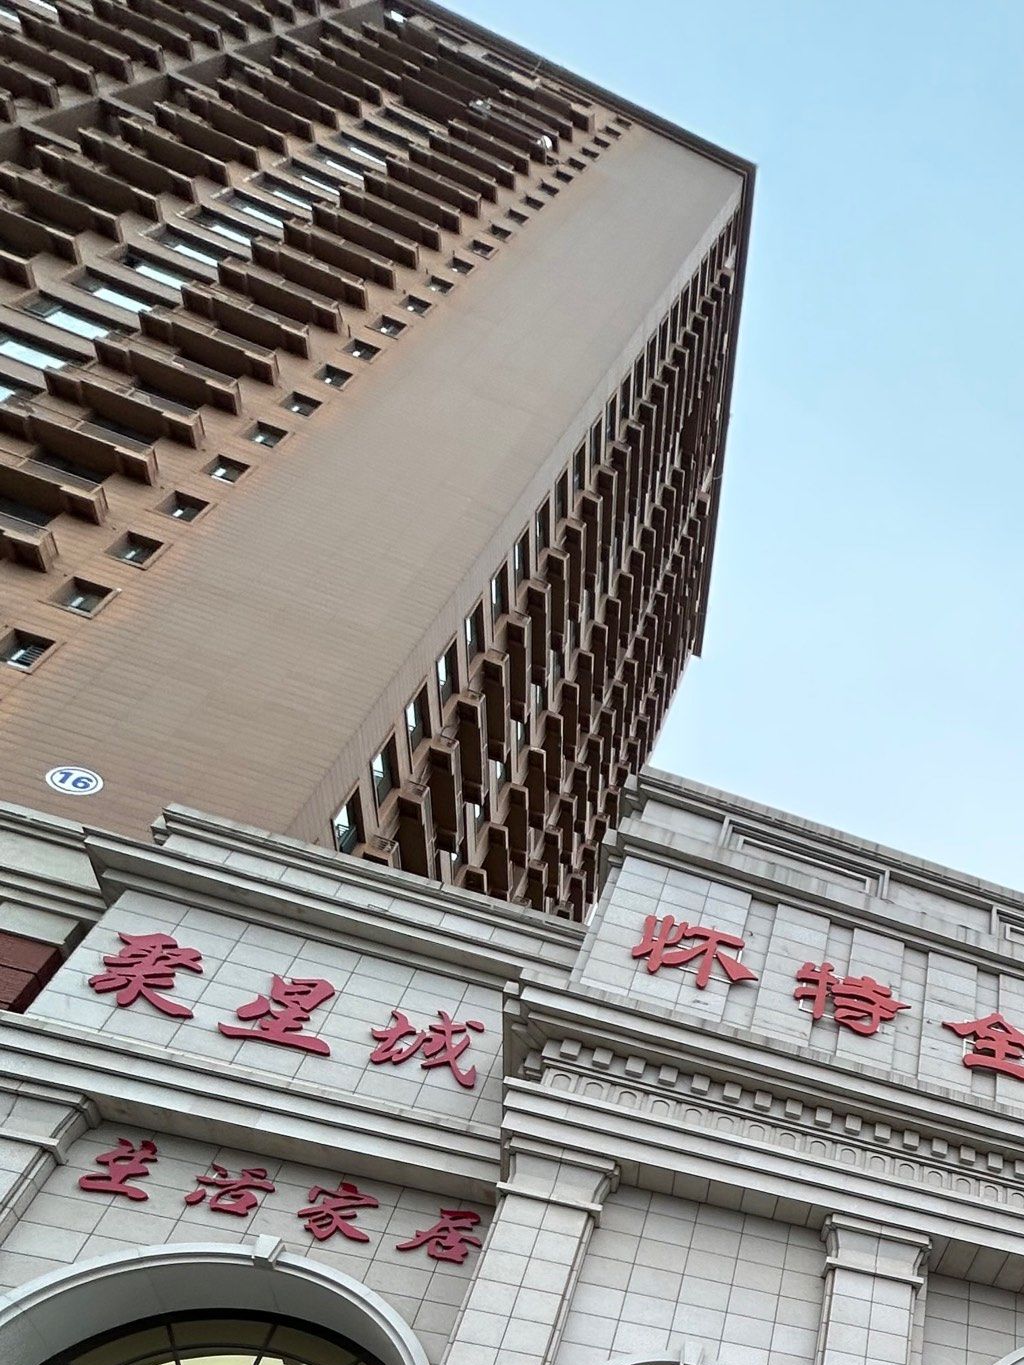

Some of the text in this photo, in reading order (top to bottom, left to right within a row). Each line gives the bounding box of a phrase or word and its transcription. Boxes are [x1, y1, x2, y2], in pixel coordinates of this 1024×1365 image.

[59, 771, 93, 790] 16
[88, 931, 486, 1089] 聚星城
[78, 1138, 483, 1265] 生活家居
